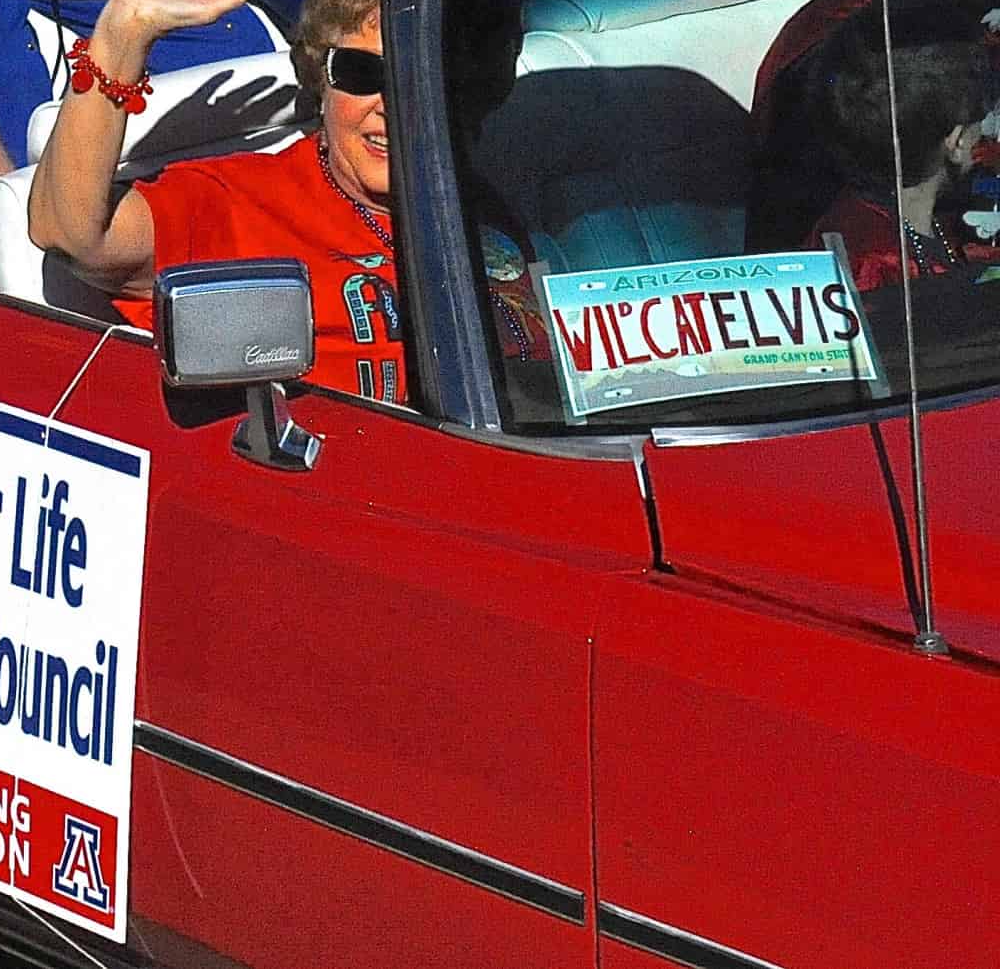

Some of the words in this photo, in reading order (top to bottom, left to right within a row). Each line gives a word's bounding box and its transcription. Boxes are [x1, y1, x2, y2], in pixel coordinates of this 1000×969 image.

[612, 262, 775, 293] ARIZONA
[245, 345, 299, 365] Cadillac
[743, 353, 779, 365] GRAND
[781, 350, 825, 362] CANYON
[826, 349, 858, 362] STAT
[10, 472, 88, 608] Life
[53, 813, 110, 915] A
